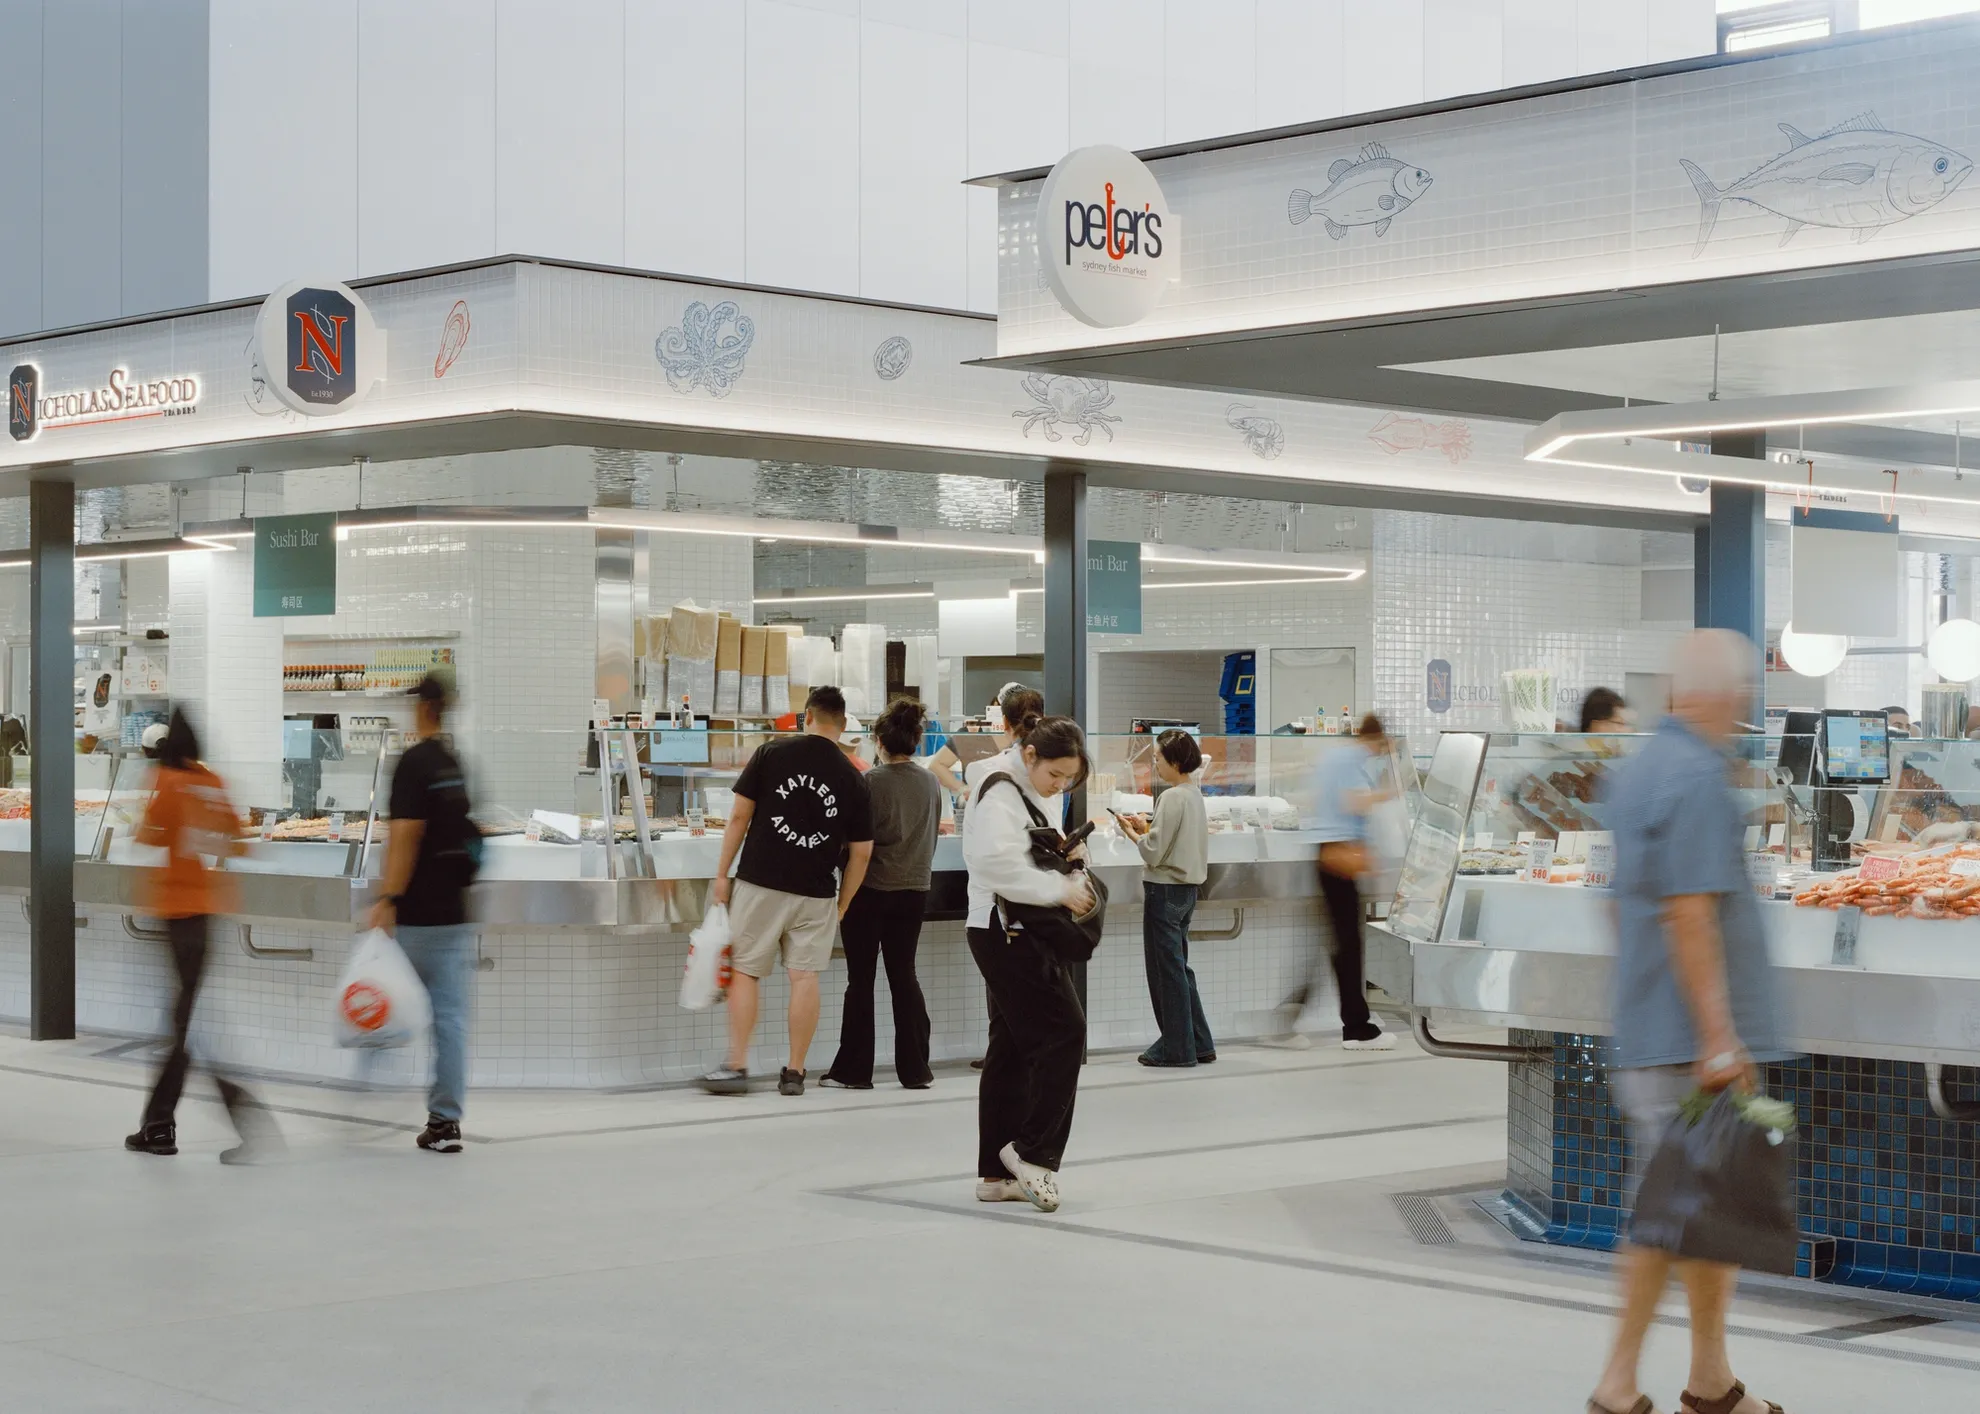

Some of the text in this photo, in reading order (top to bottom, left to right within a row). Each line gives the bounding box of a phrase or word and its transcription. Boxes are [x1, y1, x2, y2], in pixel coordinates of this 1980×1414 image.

[1065, 182, 1163, 266] peter's
[1082, 261, 1148, 277] sydney fish market
[294, 311, 348, 375] N
[163, 406, 197, 417] TRADERS
[1819, 494, 1847, 503] TRADERS
[270, 528, 319, 548] Sushi Bar
[1107, 554, 1128, 572] Bar
[281, 596, 303, 608] 寿司区
[775, 774, 838, 818] XAYLESS
[1532, 869, 1548, 879] 580
[1585, 873, 1607, 885] 2499
